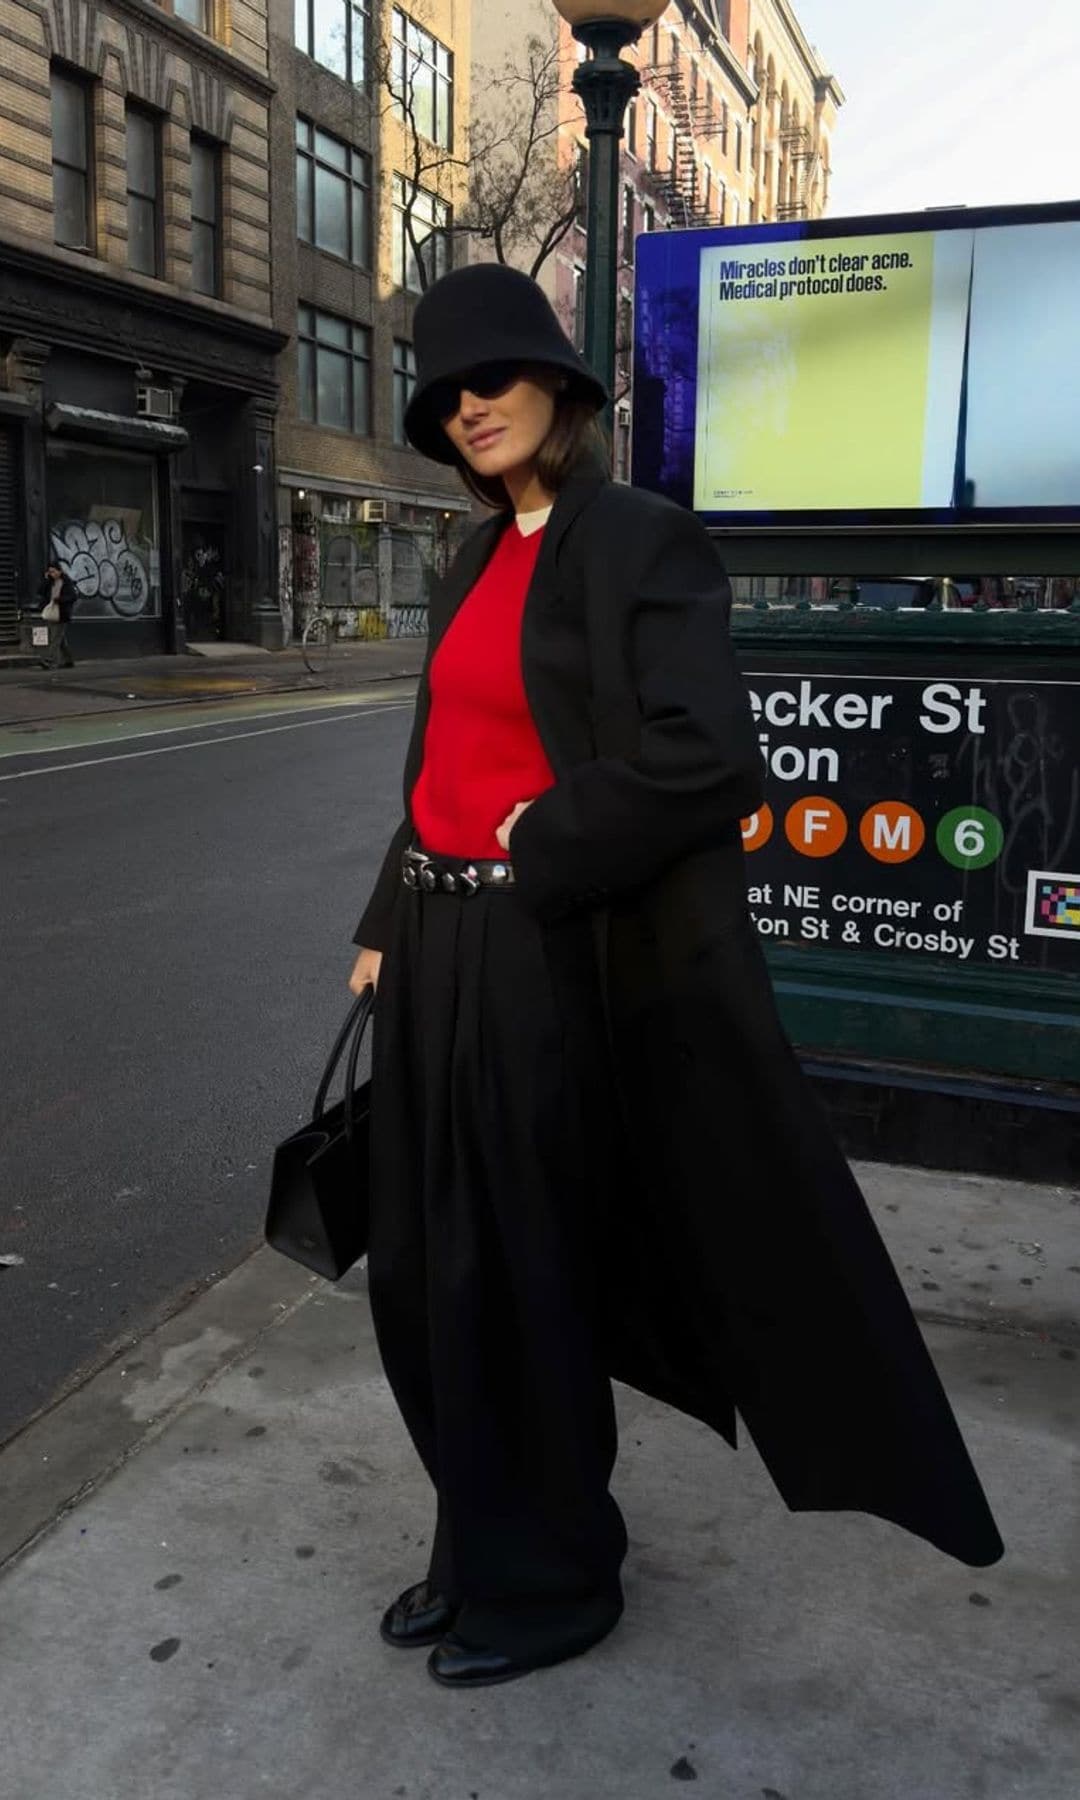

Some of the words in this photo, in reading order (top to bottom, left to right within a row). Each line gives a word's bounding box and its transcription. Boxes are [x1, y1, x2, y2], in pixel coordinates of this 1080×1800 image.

[720, 259, 786, 280] Miracles
[788, 255, 825, 276] don't
[829, 253, 869, 273] clear
[871, 252, 913, 270] acne.
[720, 278, 778, 300] Medical
[780, 274, 844, 300] protocol
[846, 273, 887, 293] does.
[919, 683, 986, 734] St
[804, 809, 830, 843] F
[873, 814, 911, 850] M
[954, 819, 985, 856] 6
[747, 884, 773, 904] at
[783, 885, 820, 909] NE
[831, 894, 922, 918] corner
[933, 900, 963, 922] of
[750, 912, 789, 936] on
[800, 916, 830, 940] St
[841, 920, 861, 944] &
[873, 923, 975, 959] Crosby
[987, 934, 1020, 960] St
